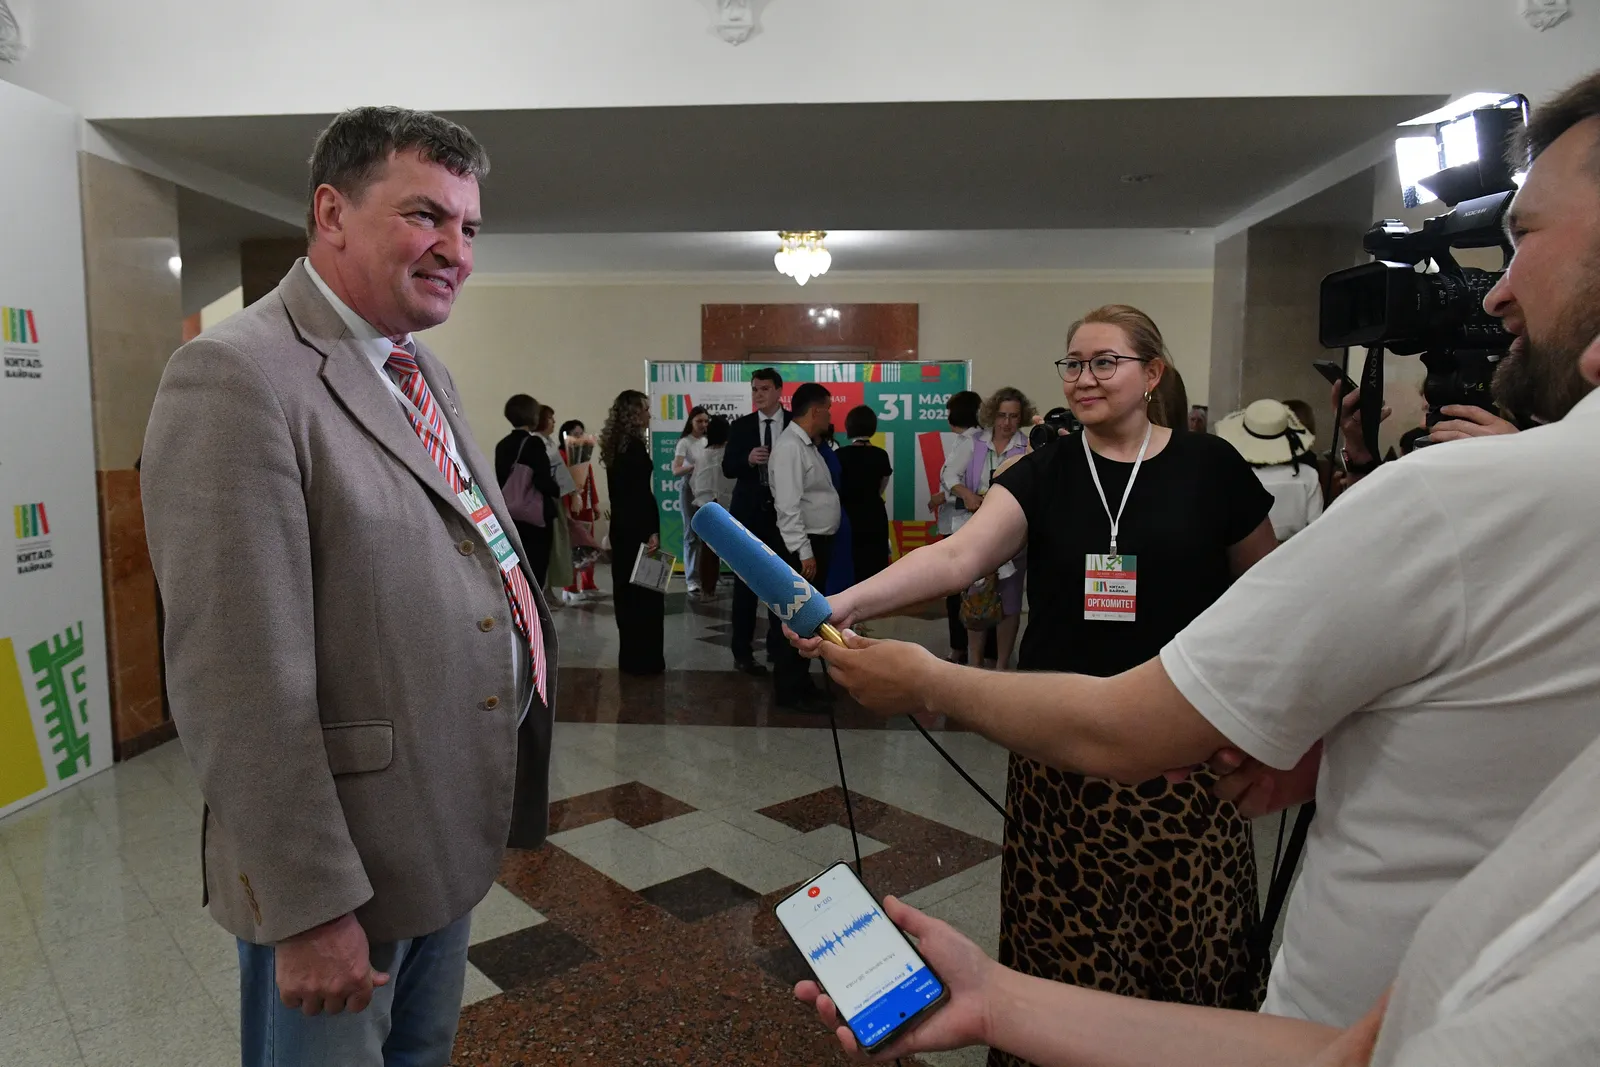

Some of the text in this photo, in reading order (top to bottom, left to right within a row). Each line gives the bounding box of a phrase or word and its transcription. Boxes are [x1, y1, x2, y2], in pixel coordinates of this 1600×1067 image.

[919, 394, 952, 405] МАЯ
[878, 394, 912, 421] 31
[1087, 598, 1134, 609] ОРГКОМИТЕТ
